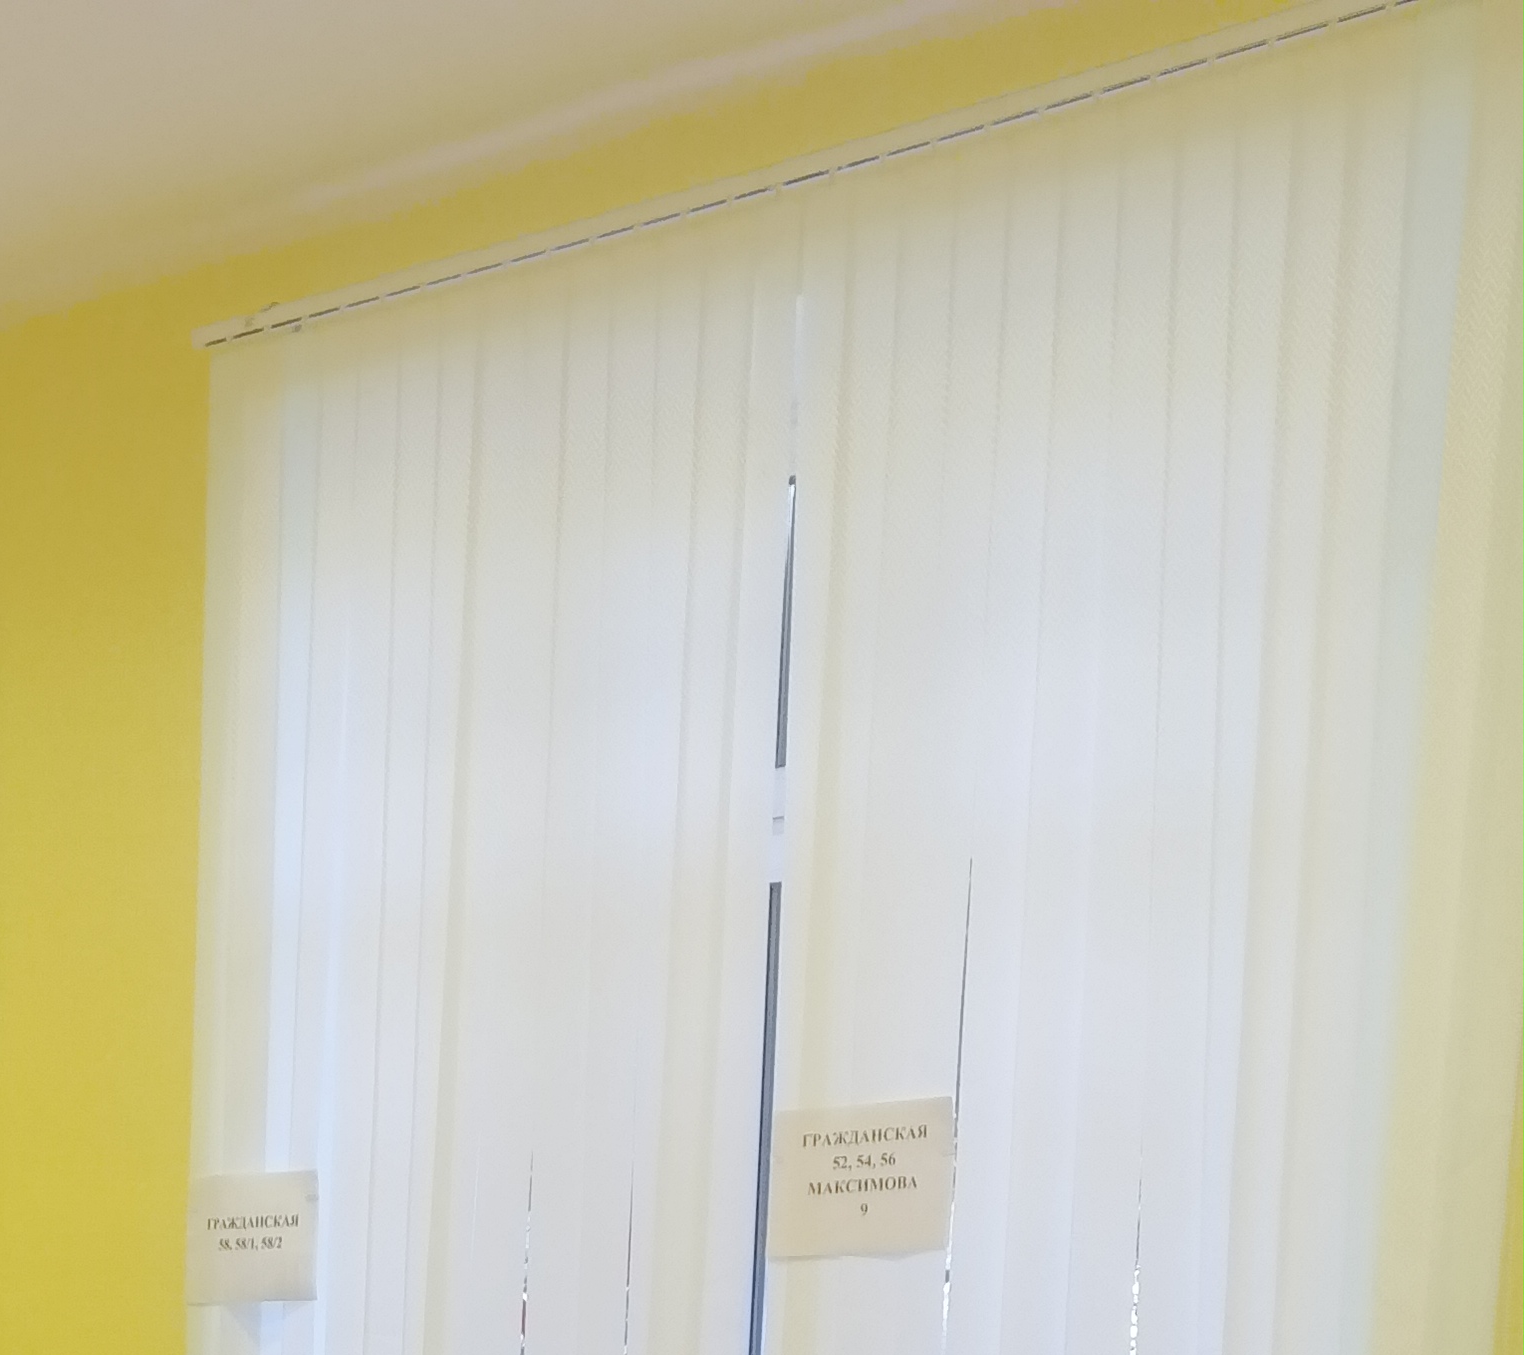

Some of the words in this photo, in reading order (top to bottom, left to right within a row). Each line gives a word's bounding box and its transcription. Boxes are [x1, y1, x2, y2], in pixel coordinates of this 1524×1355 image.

[802, 1123, 928, 1148] ГРАЖДАНСКАЯ
[832, 1155, 853, 1171] 52,
[856, 1153, 877, 1169] 54,
[880, 1152, 896, 1167] 56
[807, 1176, 918, 1196] МАКСИМОВА
[860, 1203, 869, 1216] 9
[207, 1213, 299, 1231] ГРАЖДАНСКАЯ
